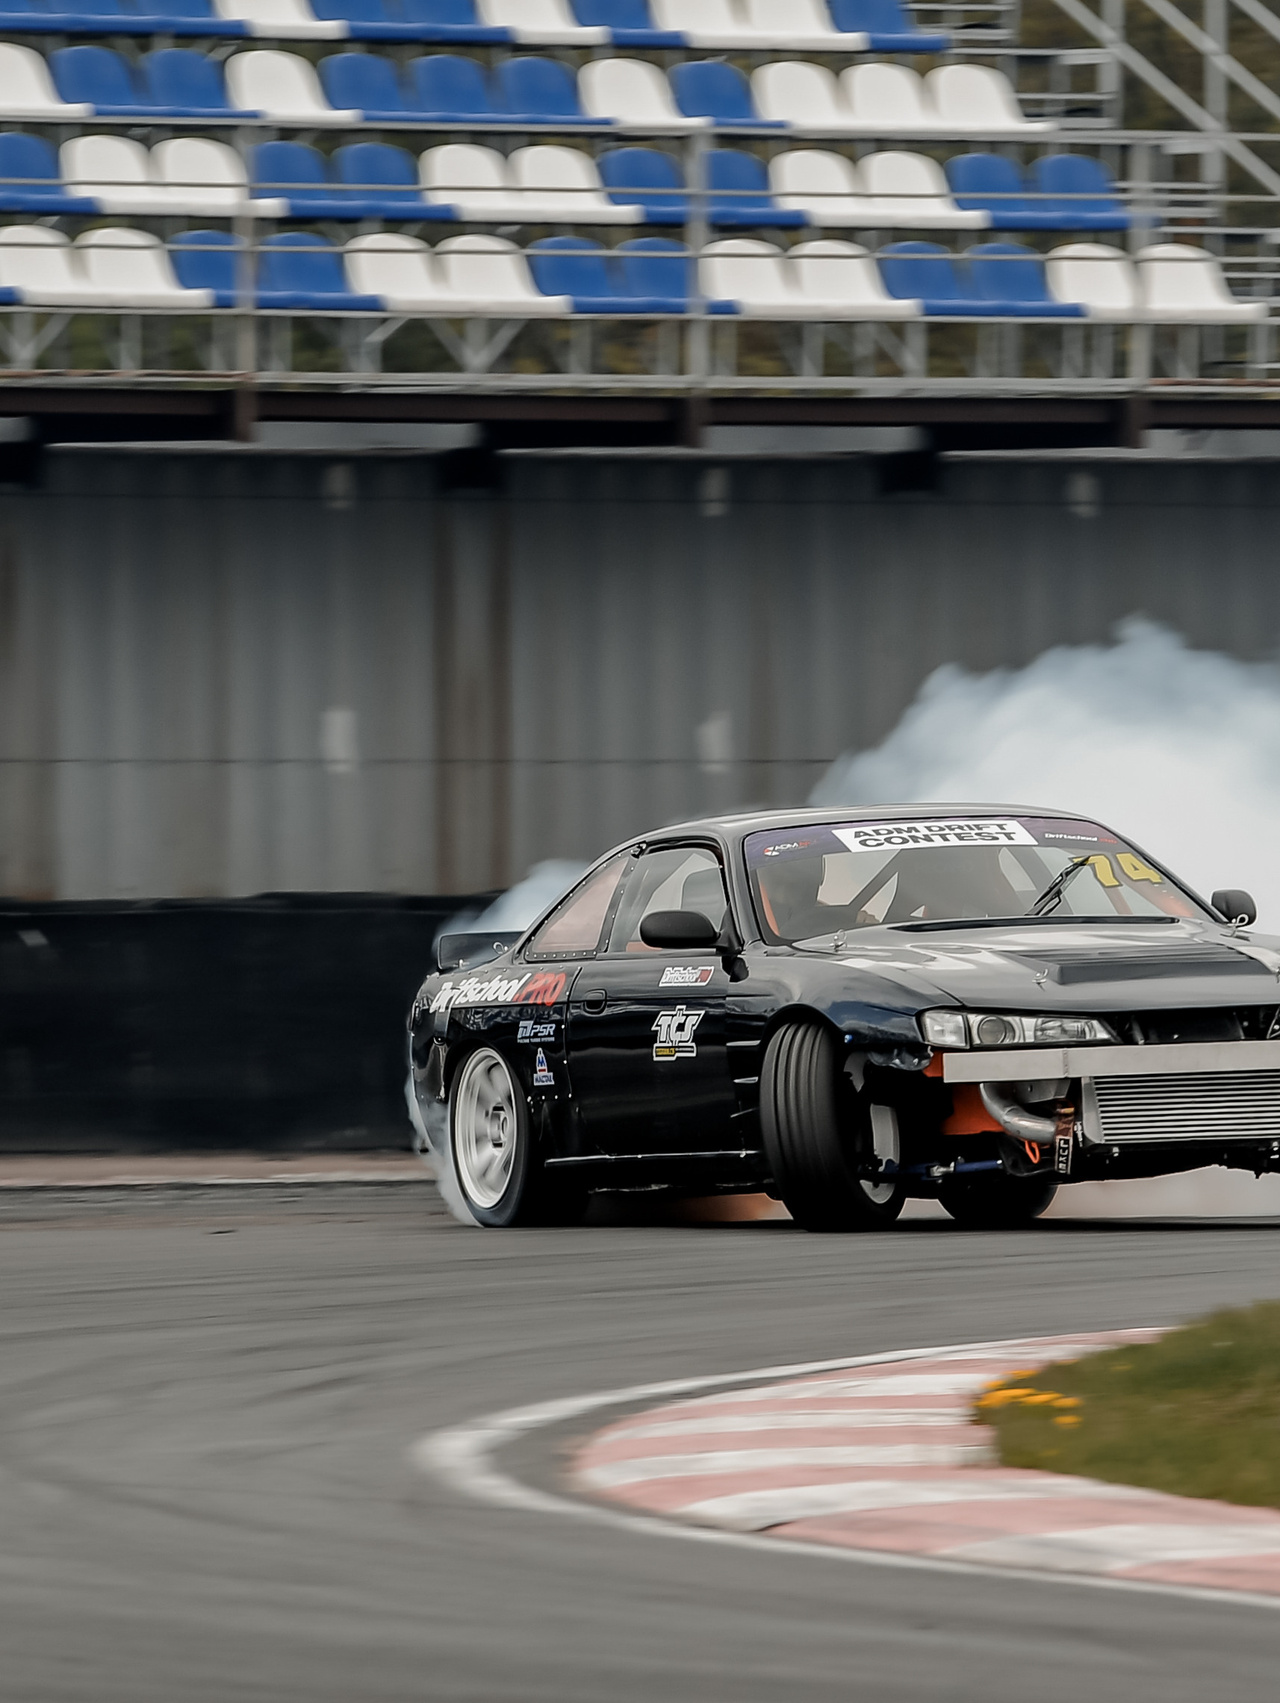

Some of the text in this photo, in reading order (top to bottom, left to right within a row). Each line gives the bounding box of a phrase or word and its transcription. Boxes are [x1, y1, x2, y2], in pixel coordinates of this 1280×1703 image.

[854, 823, 1008, 839] ADM DRIFT
[858, 831, 1016, 848] CONTEST
[657, 1010, 700, 1043] TCS
